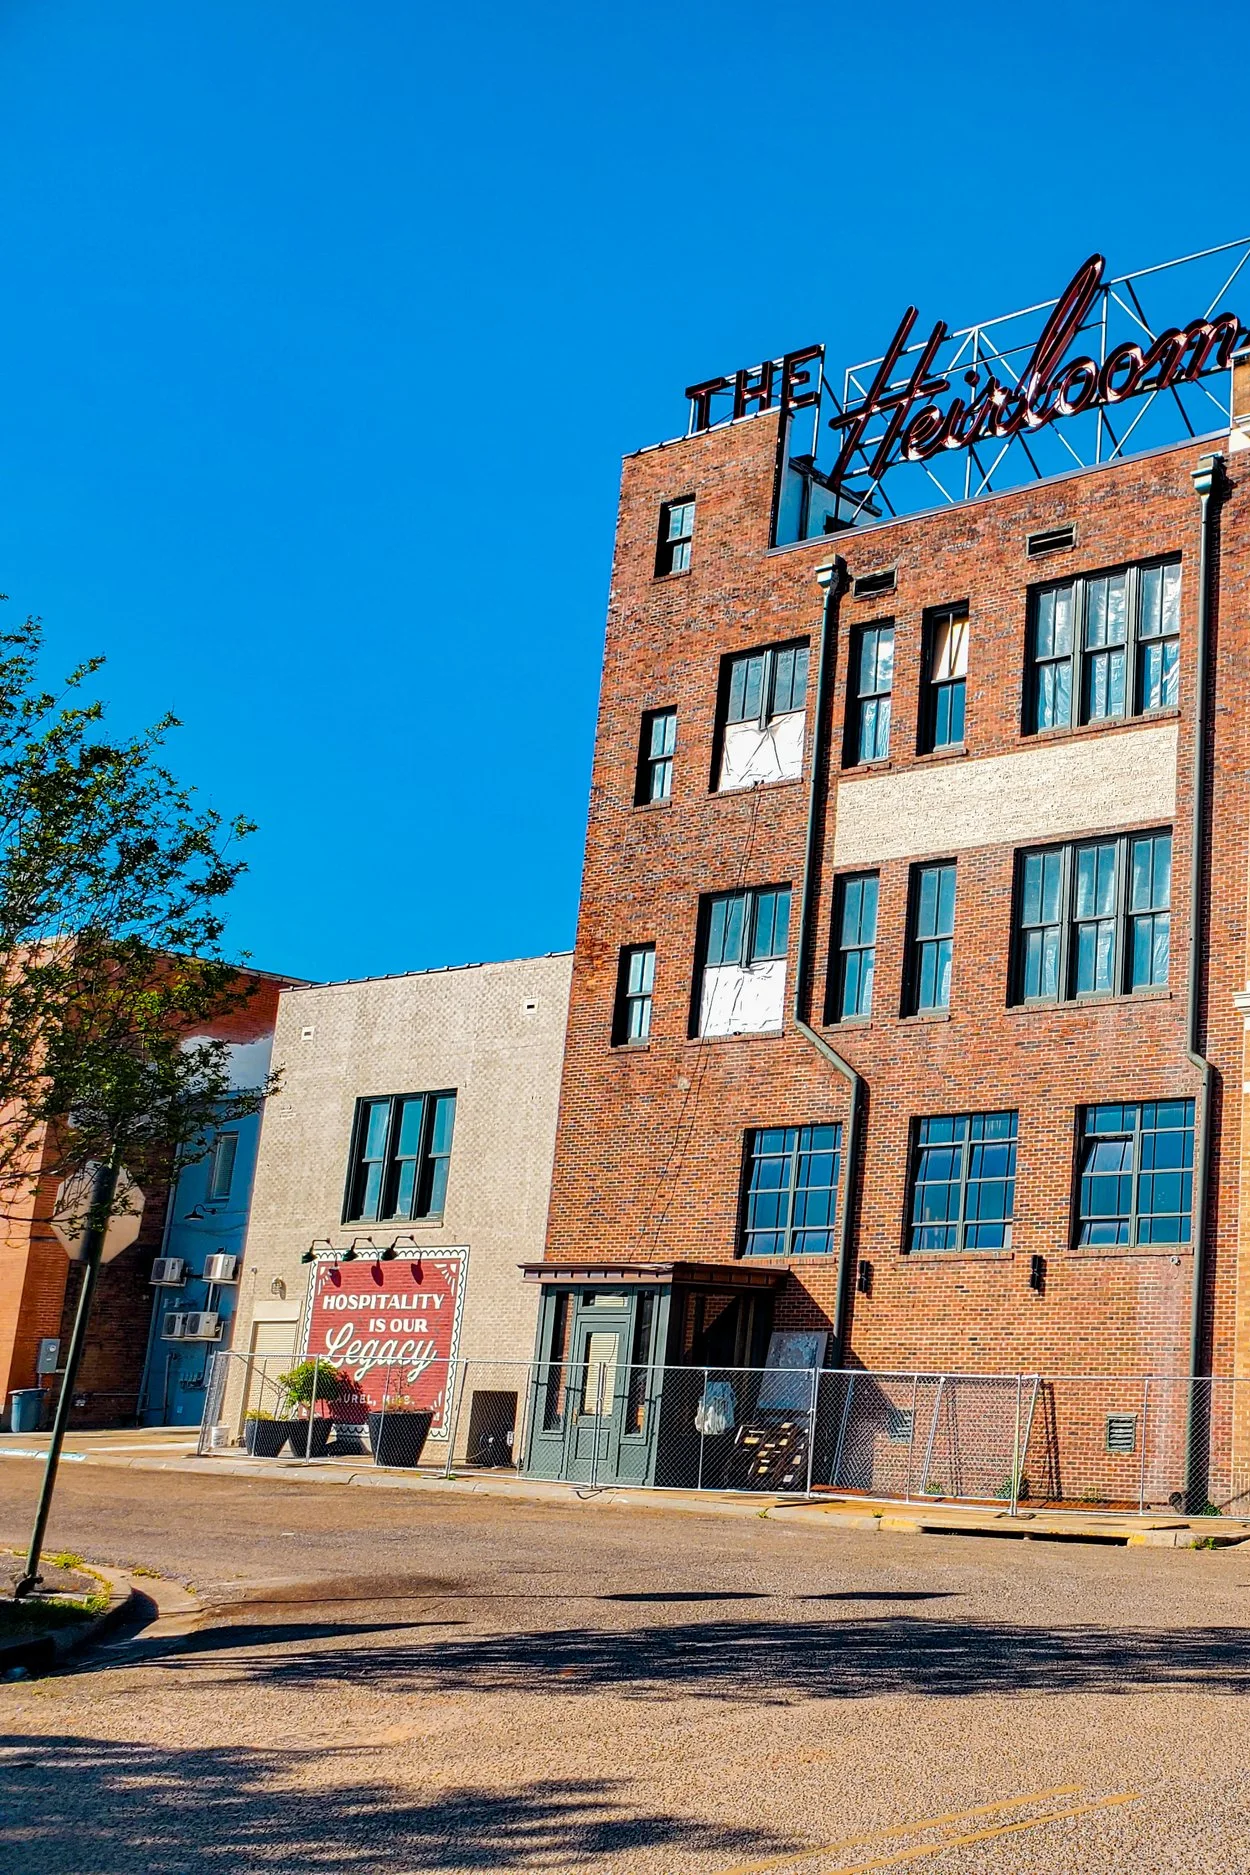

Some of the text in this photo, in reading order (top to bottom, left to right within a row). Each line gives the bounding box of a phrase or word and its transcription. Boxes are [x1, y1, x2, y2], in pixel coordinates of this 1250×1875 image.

[685, 344, 820, 432] THE
[322, 1293, 445, 1310] HOSPITALITY
[369, 1318, 428, 1333] IS OUR
[325, 1322, 437, 1382] Legacy
[337, 1393, 376, 1406] UREL,
